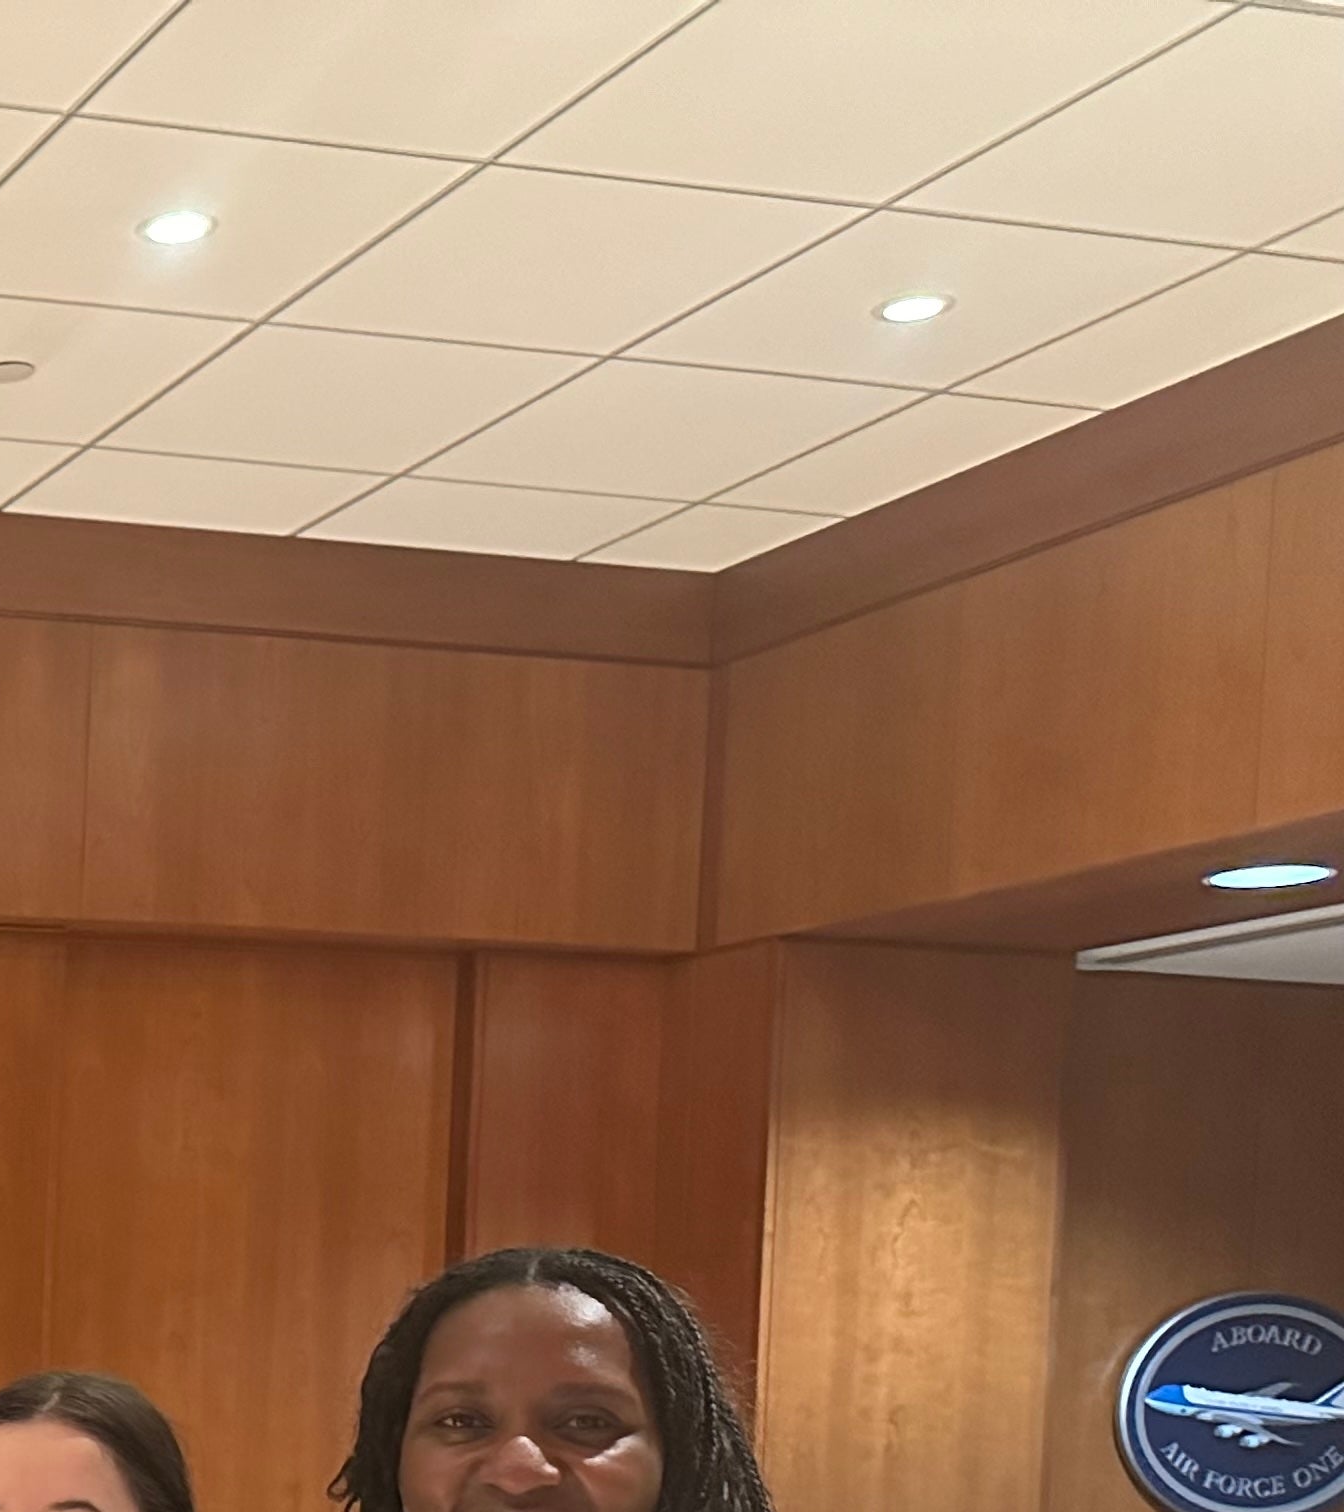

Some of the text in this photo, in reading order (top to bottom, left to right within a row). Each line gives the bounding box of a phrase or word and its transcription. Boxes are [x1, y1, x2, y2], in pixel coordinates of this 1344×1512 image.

[1211, 1324, 1322, 1356] ABOARD
[1160, 1441, 1344, 1498] AIR FORCE ONE
